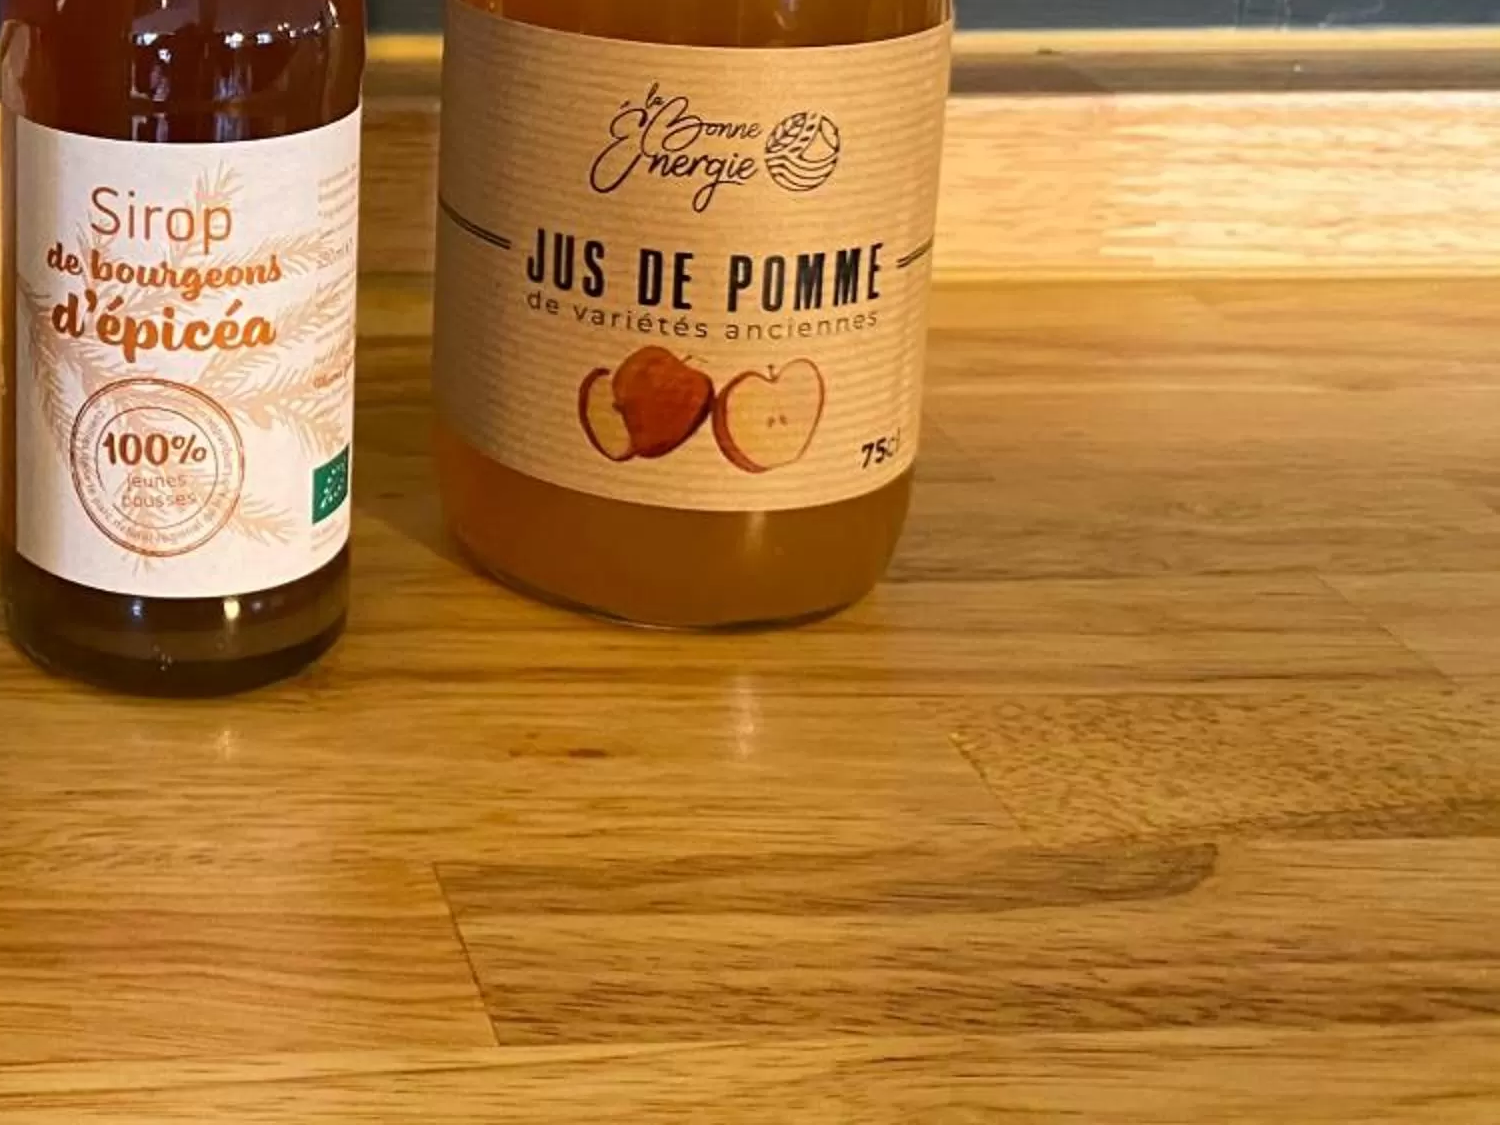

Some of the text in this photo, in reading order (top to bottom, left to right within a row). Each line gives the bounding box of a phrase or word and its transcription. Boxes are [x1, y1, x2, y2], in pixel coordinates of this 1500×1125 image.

[646, 82, 665, 108] la
[589, 100, 759, 213] Énergie
[641, 96, 762, 162] Bonne
[90, 186, 233, 255] Sirop
[47, 242, 83, 275] de
[91, 249, 282, 301] bourgeons
[527, 228, 884, 313] JUS DE POMME
[527, 291, 879, 341] de variétés anciennes
[102, 431, 207, 466] 100%
